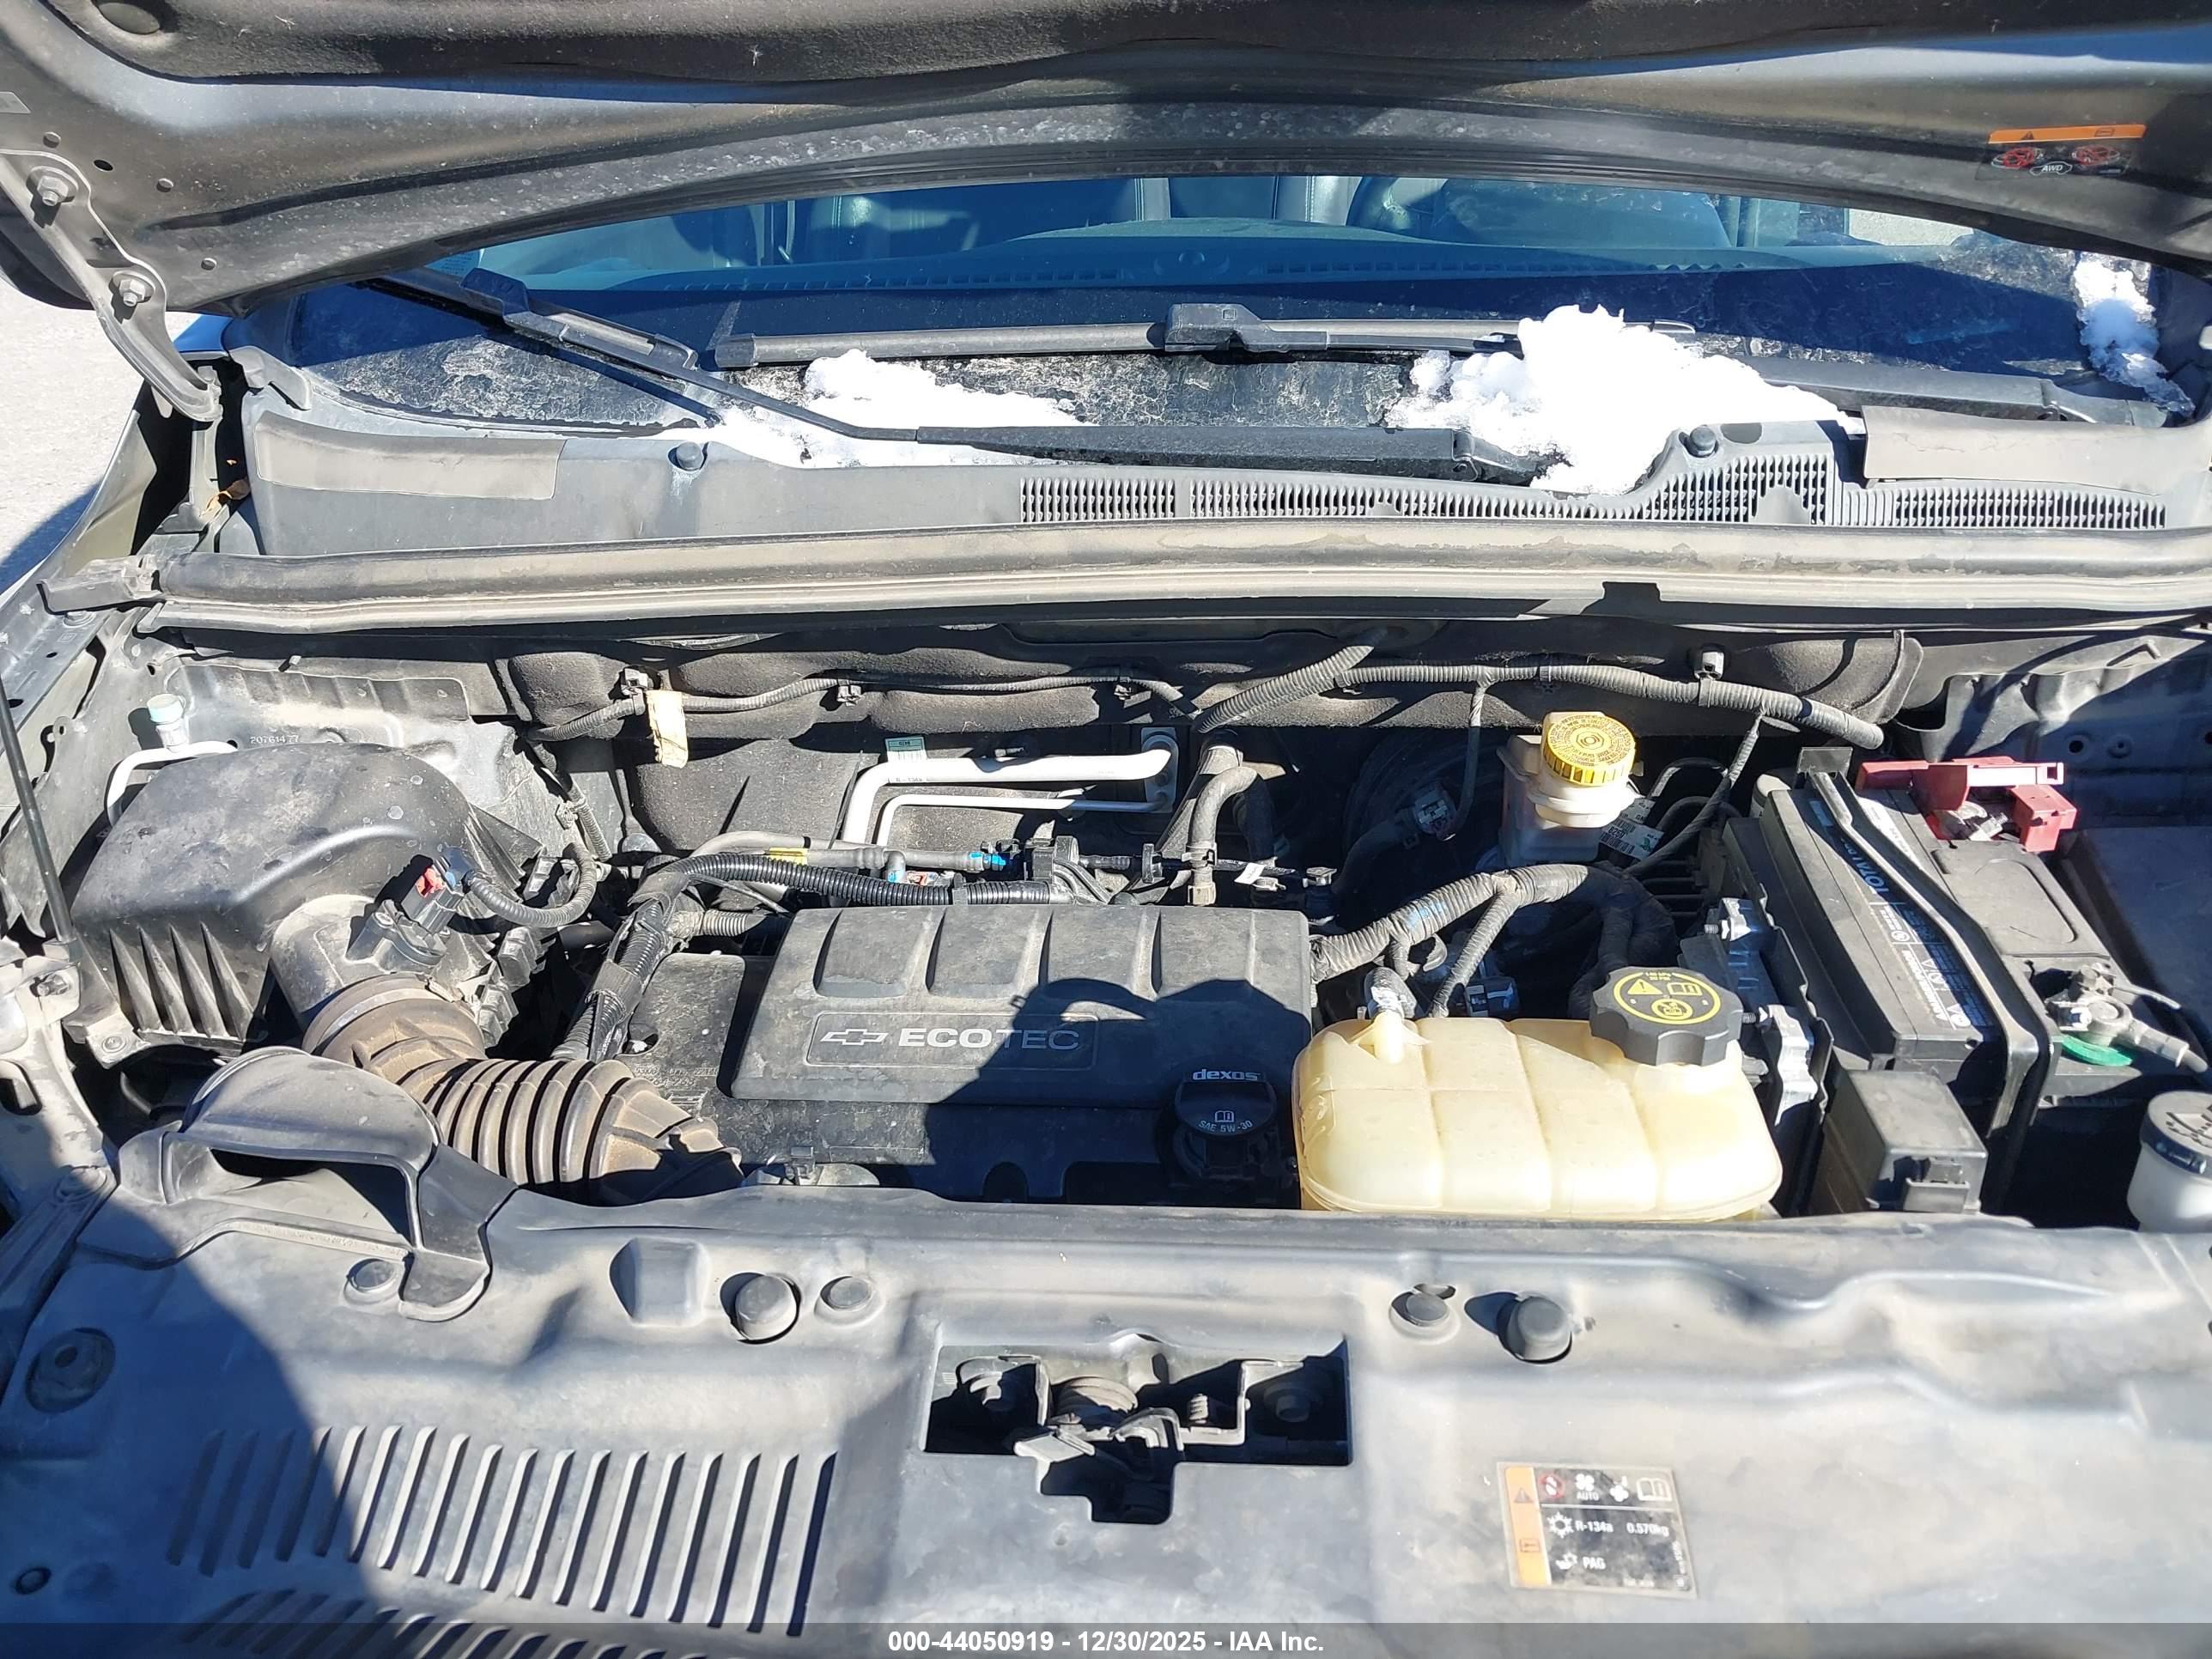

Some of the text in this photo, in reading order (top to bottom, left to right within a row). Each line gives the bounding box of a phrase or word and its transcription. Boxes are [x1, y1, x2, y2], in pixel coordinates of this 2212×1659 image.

[2041, 164, 2063, 173] AWD
[898, 1028, 1080, 1050] ECOTEC
[1192, 1068, 1260, 1081] dexos
[1198, 1120, 1254, 1133] SAE 5W-30
[1577, 1492, 1599, 1501] AUTO
[1575, 1521, 1614, 1533] R-134a
[1583, 1557, 1607, 1570] PAG
